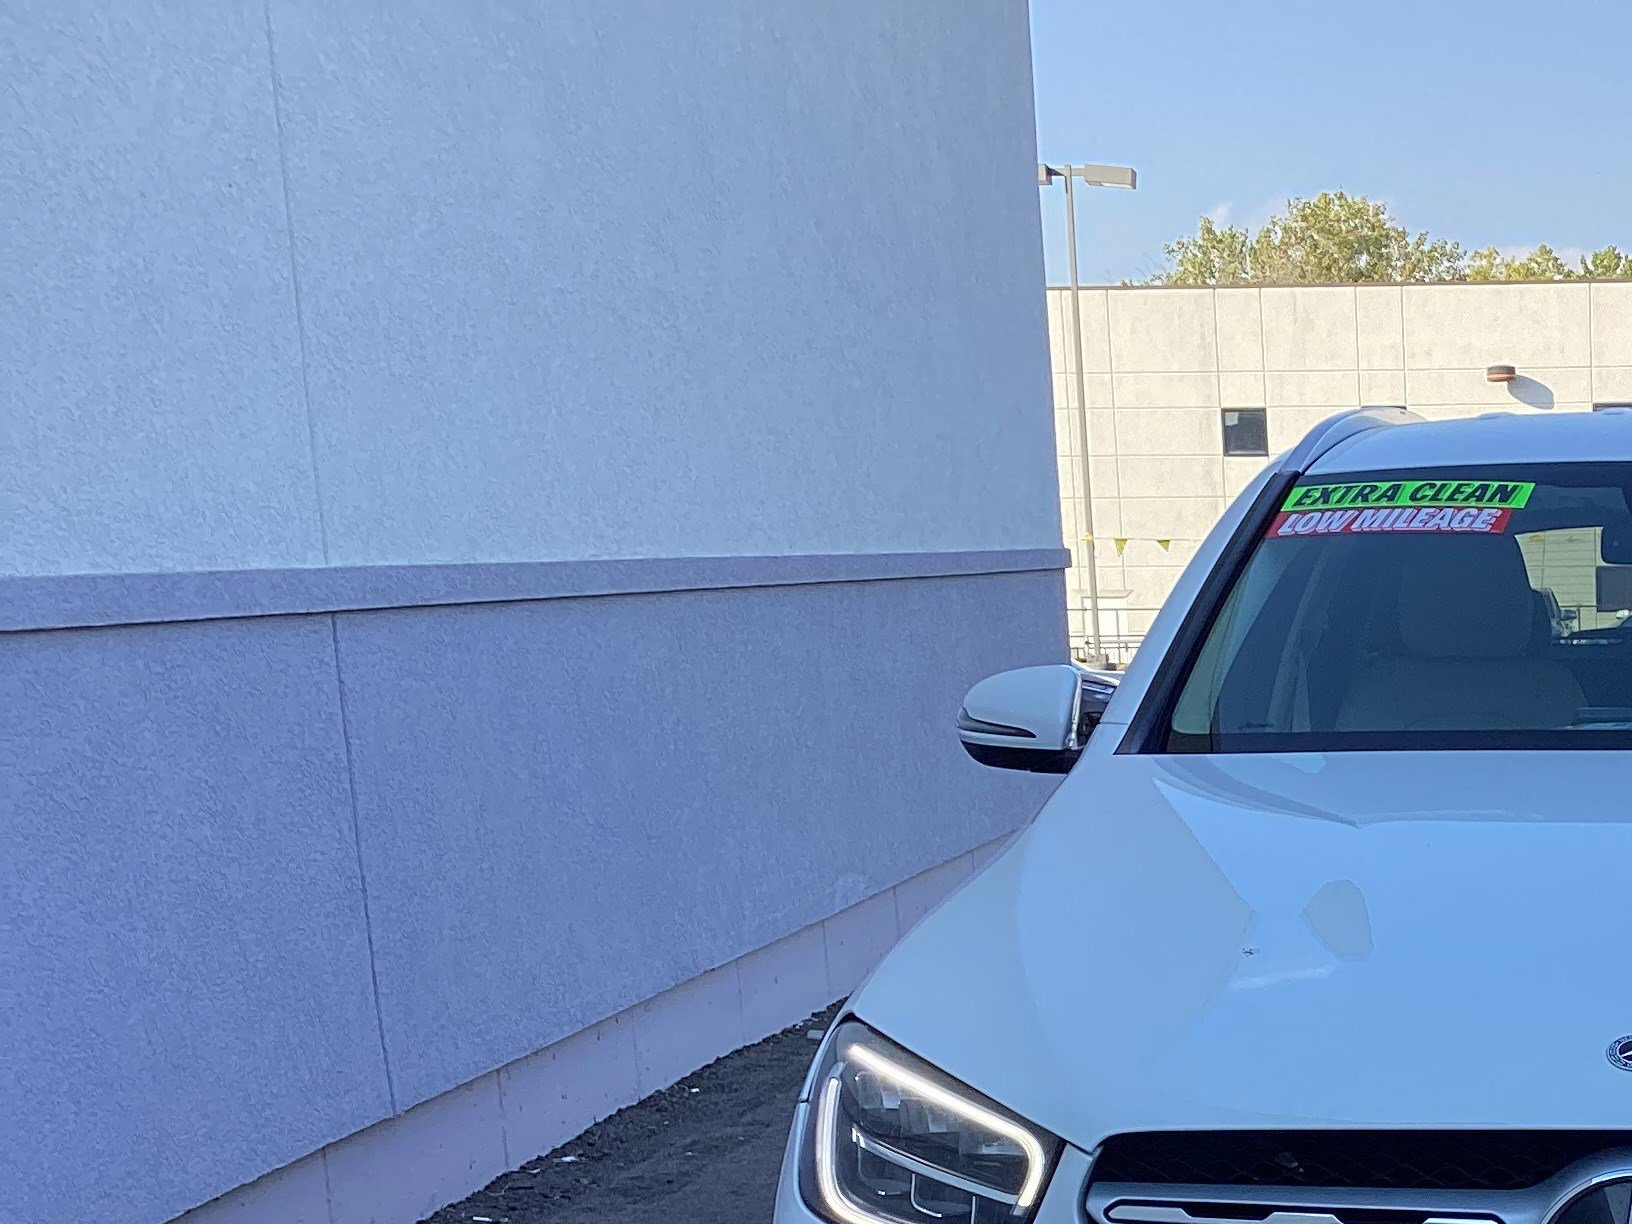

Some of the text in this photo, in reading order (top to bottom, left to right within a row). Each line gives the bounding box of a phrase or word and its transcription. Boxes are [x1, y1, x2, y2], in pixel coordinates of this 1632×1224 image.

[1292, 481, 1521, 507] EXTRA CLEAN
[1278, 507, 1503, 536] LOW MILEAGE
